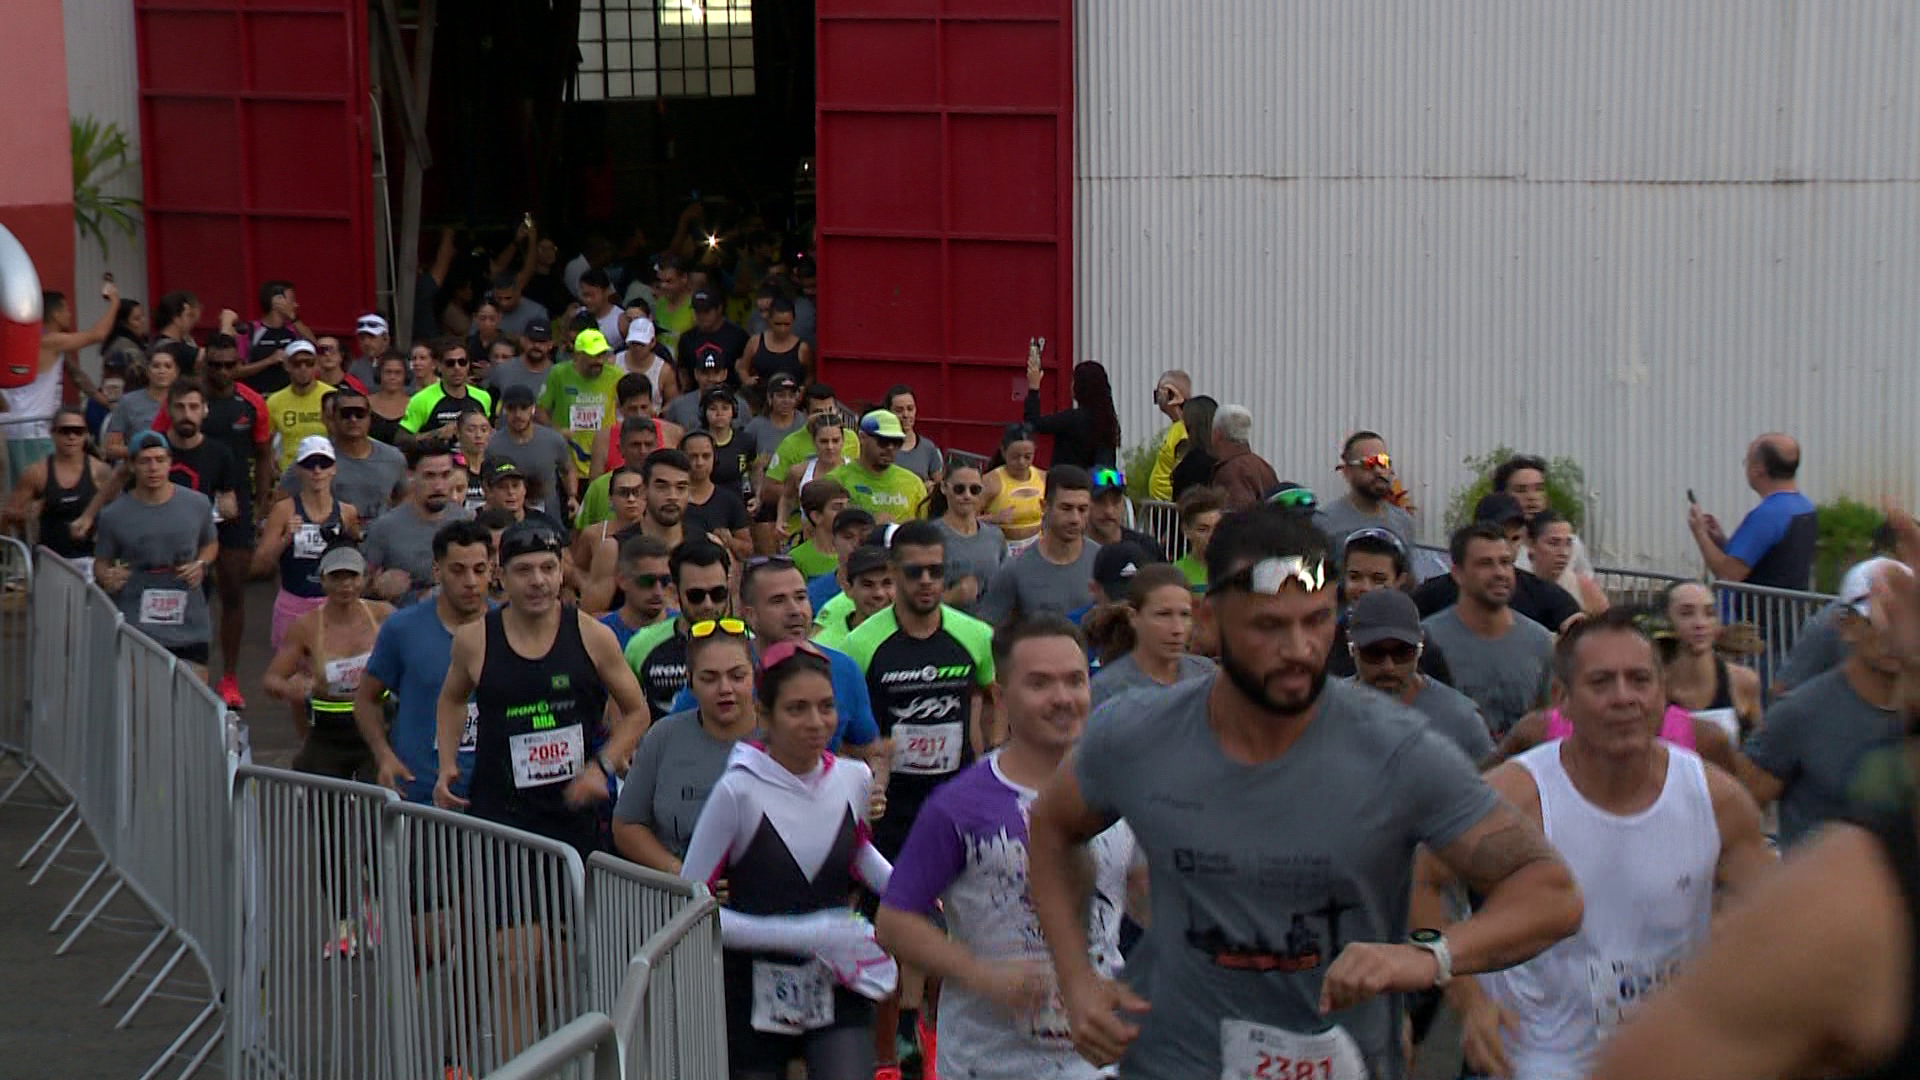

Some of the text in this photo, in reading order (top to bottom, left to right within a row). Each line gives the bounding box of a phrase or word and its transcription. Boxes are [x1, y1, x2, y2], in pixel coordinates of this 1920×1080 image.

[881, 664, 972, 684] IRON TRI
[528, 741, 570, 763] 2082
[1254, 1050, 1333, 1080] 2381
